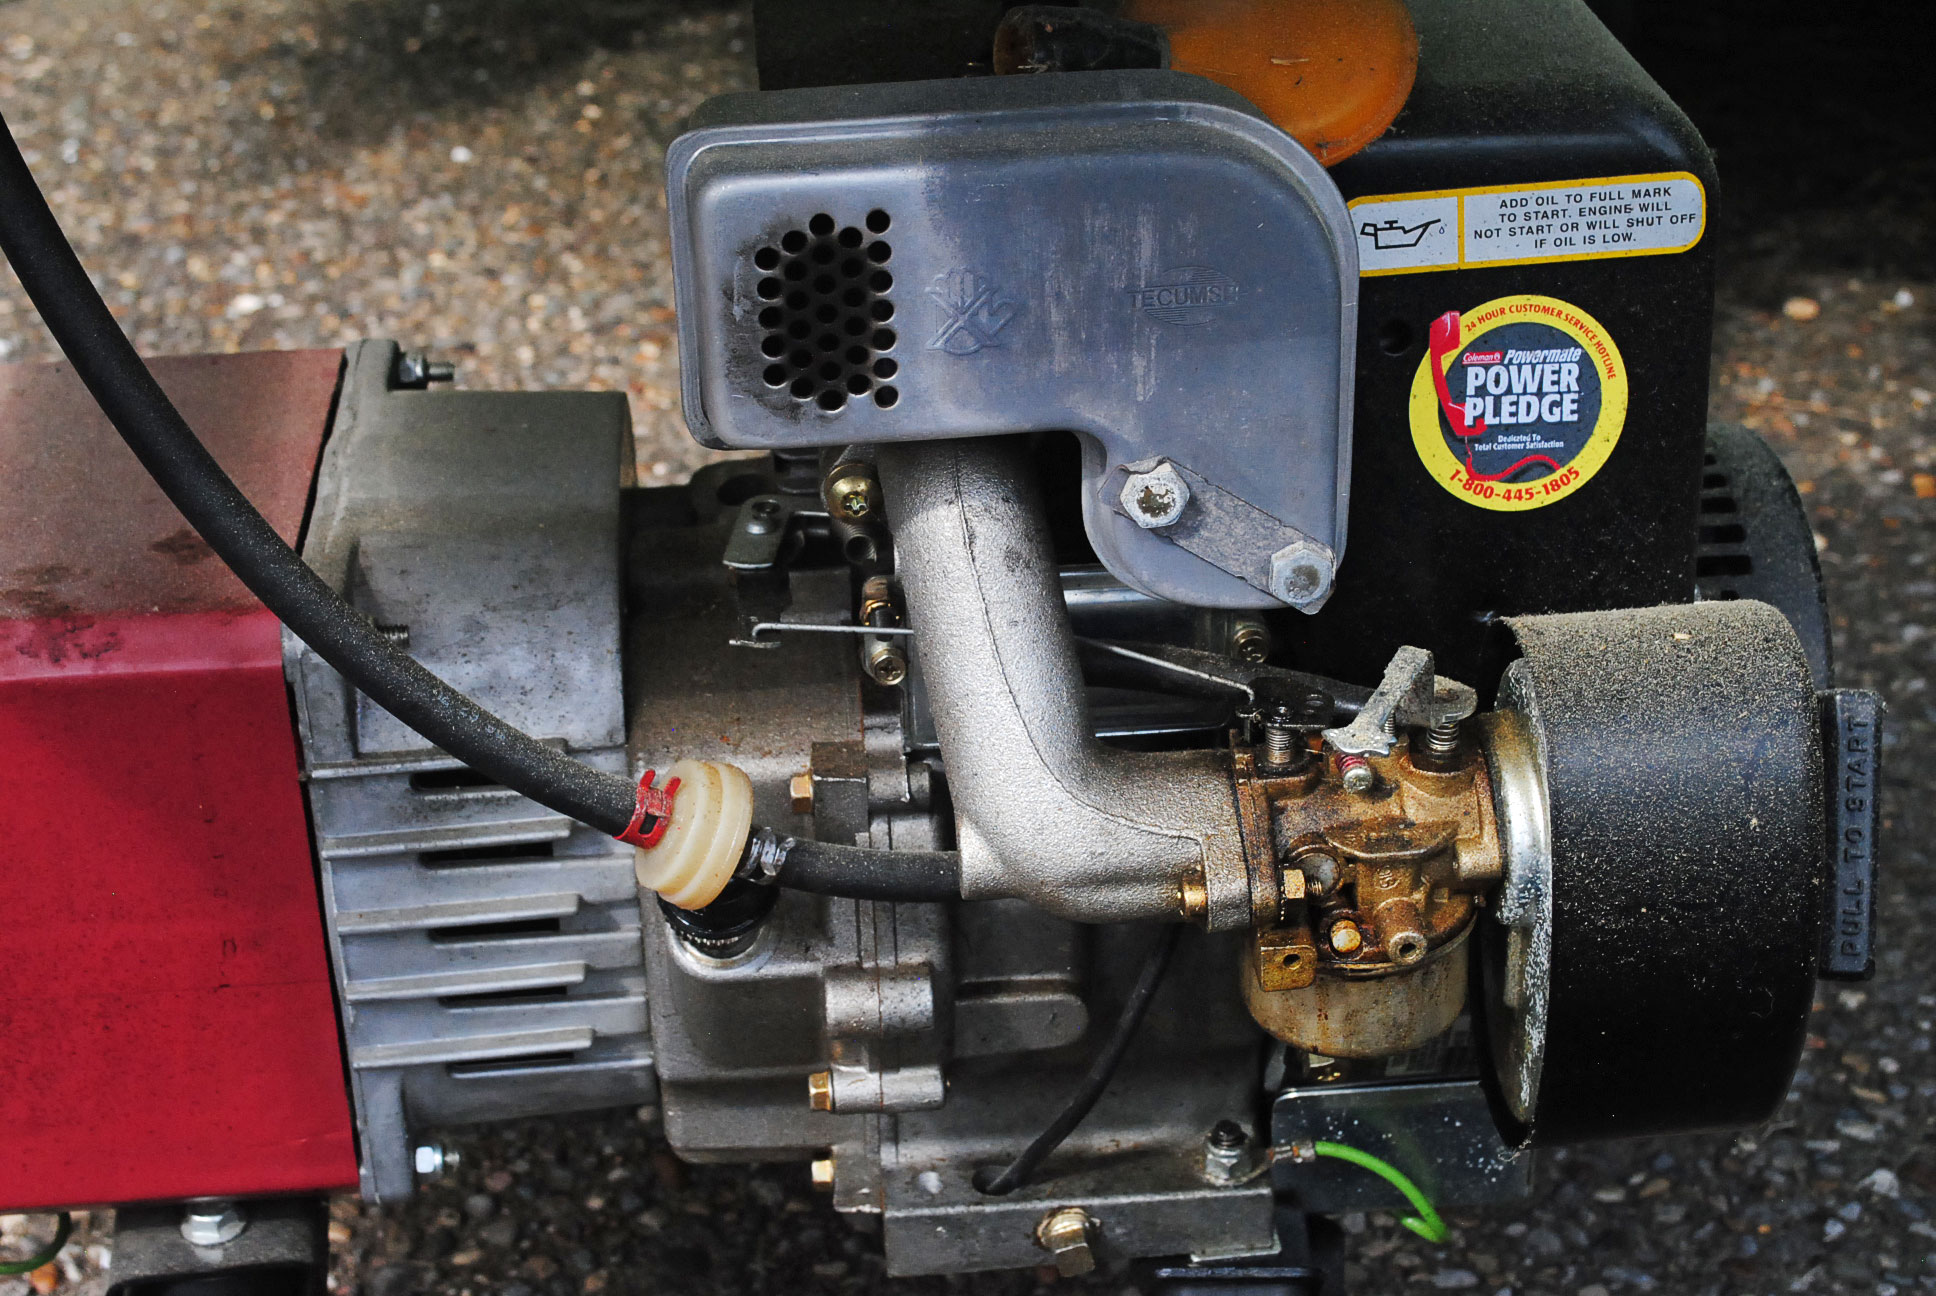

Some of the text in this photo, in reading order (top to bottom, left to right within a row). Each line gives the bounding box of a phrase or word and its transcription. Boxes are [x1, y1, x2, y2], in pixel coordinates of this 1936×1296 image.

[1500, 186, 1672, 209] ADD OIL TO FULL MARK
[1499, 201, 1672, 223] TO START. ENGINE WILL
[1474, 213, 1697, 239] NOT START OR WILL SHUT OFF
[1534, 232, 1636, 249] IF OIL IS LOW.
[1464, 303, 1616, 380] 24 HOUR CUSTOMER SERVICE HOTLINE
[1463, 347, 1582, 364] Coleman Powermate
[1466, 363, 1580, 396] POWER
[1464, 392, 1579, 426] PLEDGE
[1474, 440, 1564, 451] Total Customer Satisfaction
[1498, 433, 1541, 443] Dedicated To
[1449, 466, 1580, 501] 1-800-445-1805
[1841, 716, 1868, 957] PULL TO START
